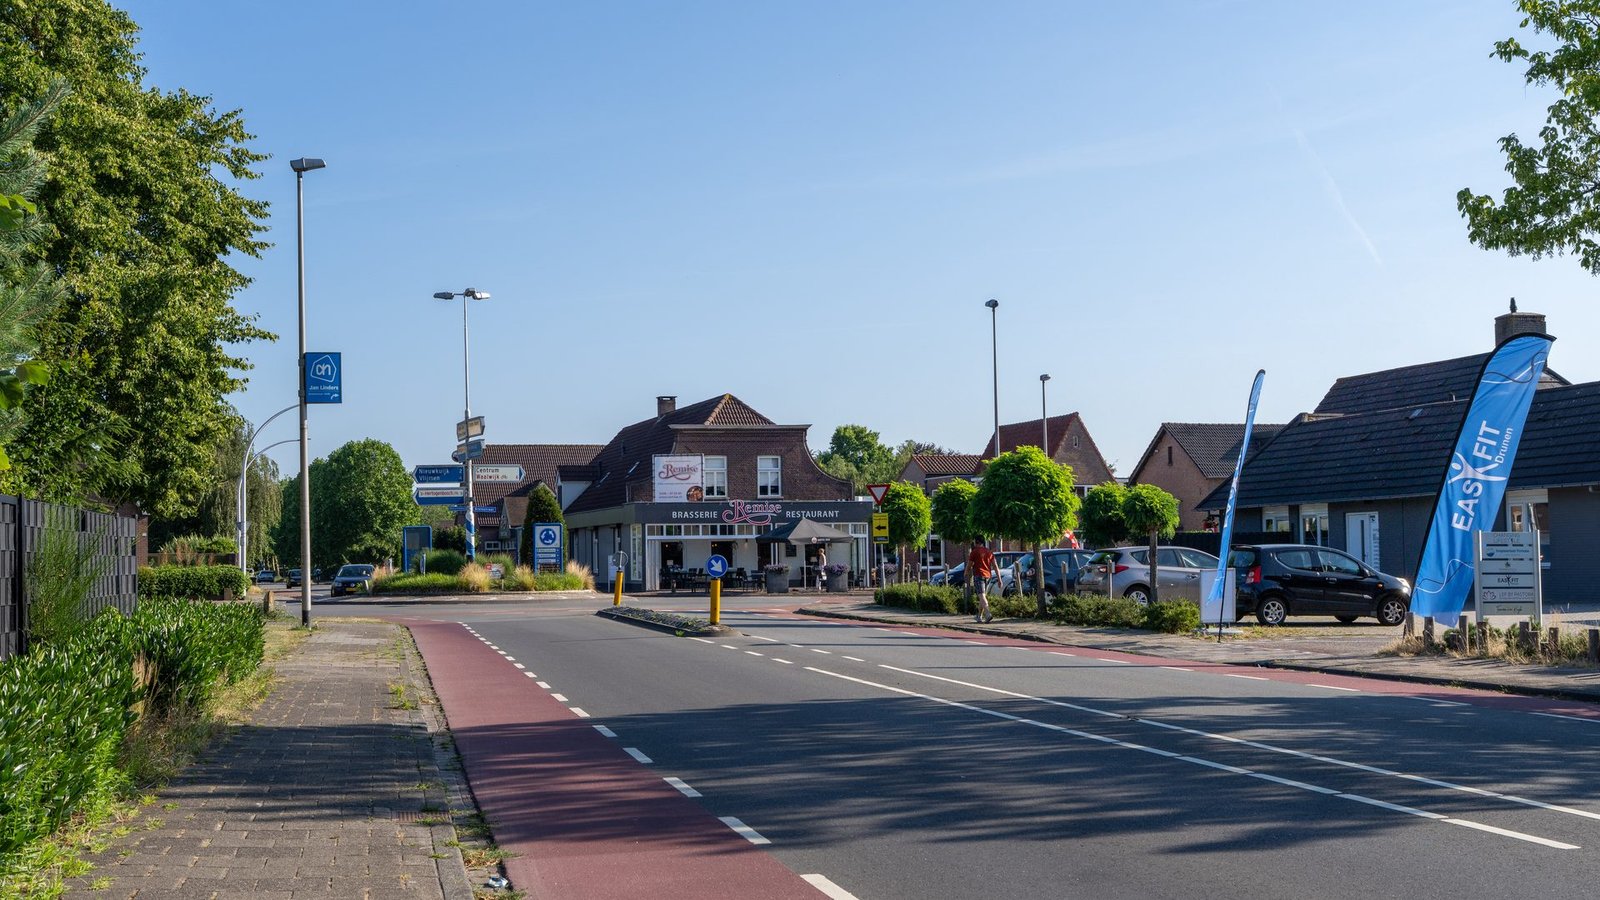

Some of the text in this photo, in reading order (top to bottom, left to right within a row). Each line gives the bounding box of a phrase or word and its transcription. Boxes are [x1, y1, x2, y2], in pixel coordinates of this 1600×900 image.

[1494, 427, 1514, 464] Drunen
[658, 463, 699, 481] Remise
[671, 510, 840, 519] BRASSERIE RESTAURANT
[721, 499, 783, 526] Remise
